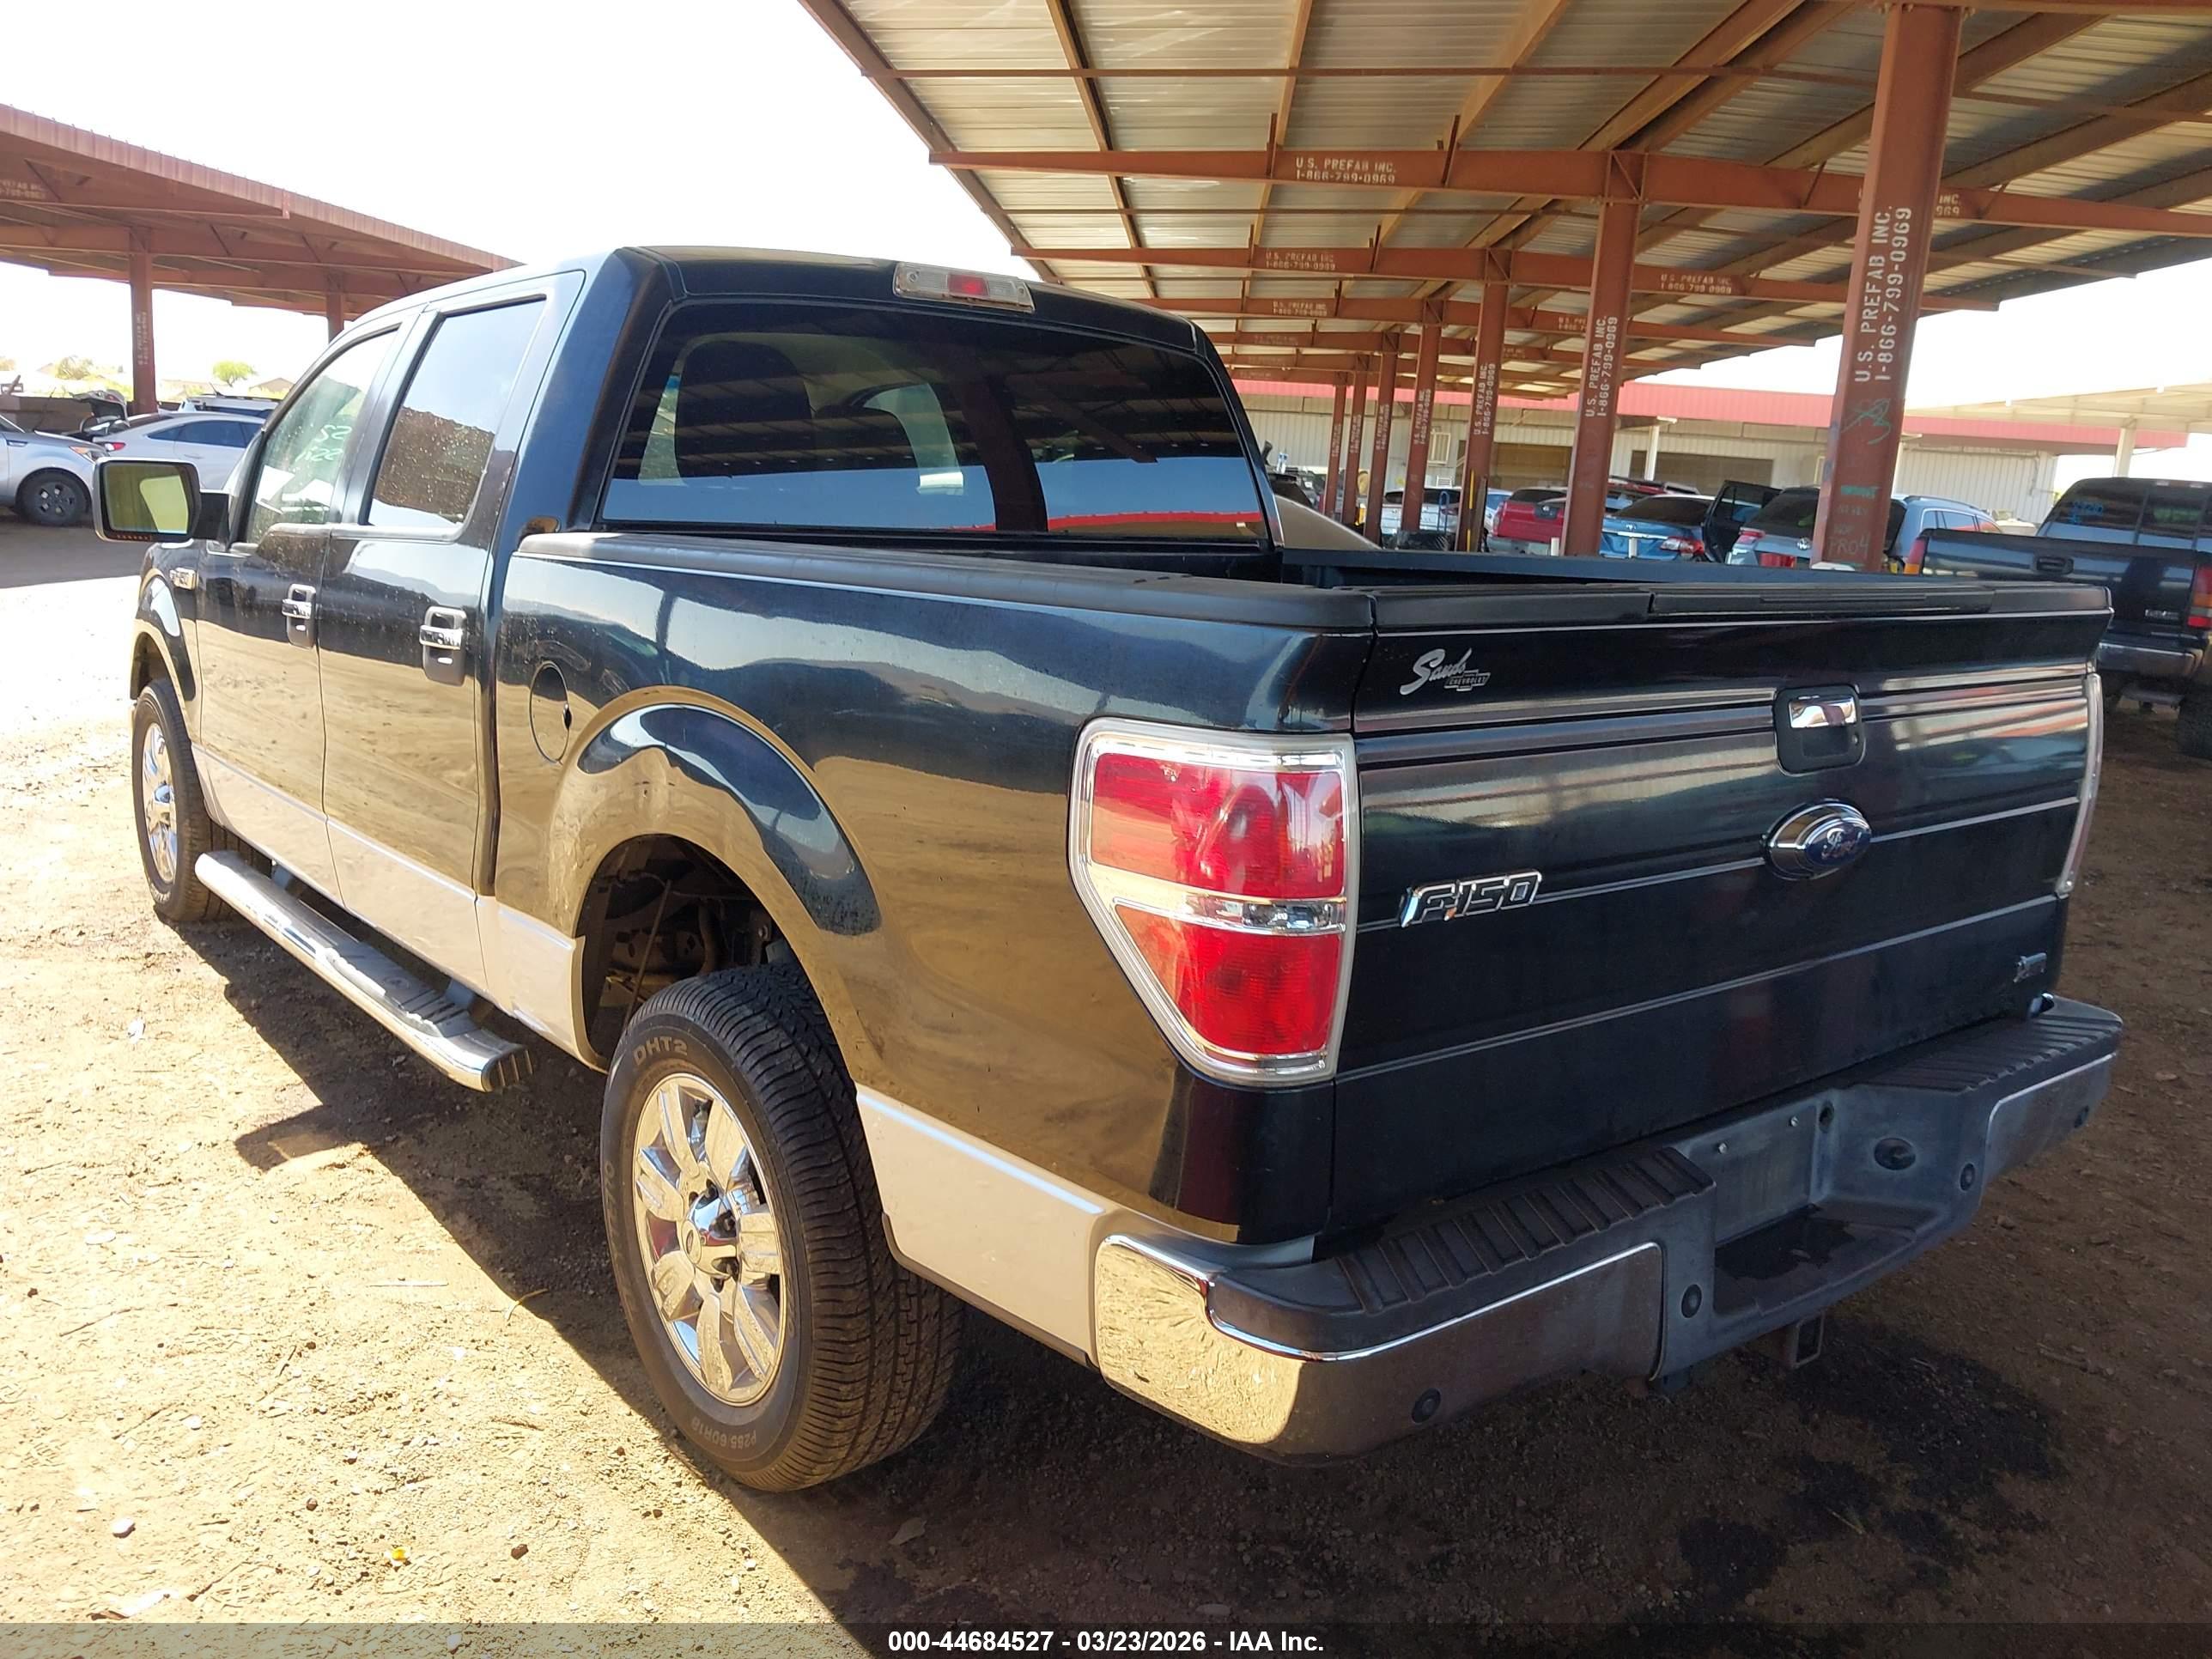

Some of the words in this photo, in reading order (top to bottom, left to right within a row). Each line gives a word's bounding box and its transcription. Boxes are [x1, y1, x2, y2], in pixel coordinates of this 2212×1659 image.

[1296, 169, 1396, 184] 1-866-799-0969
[1323, 158, 1370, 172] PREFAB
[1374, 161, 1397, 173] INC.
[1871, 205, 1893, 245] INC.
[1860, 254, 1886, 333] PREFAB
[1875, 207, 1912, 380] 1-866-799-0969
[1595, 315, 1607, 338] INC.
[1589, 343, 1604, 389] PREFAB
[1597, 316, 1618, 417] 1-866-799-0969
[1854, 343, 1875, 382] U.S.
[1399, 647, 1473, 696] Sands
[632, 1036, 689, 1066] DHT2
